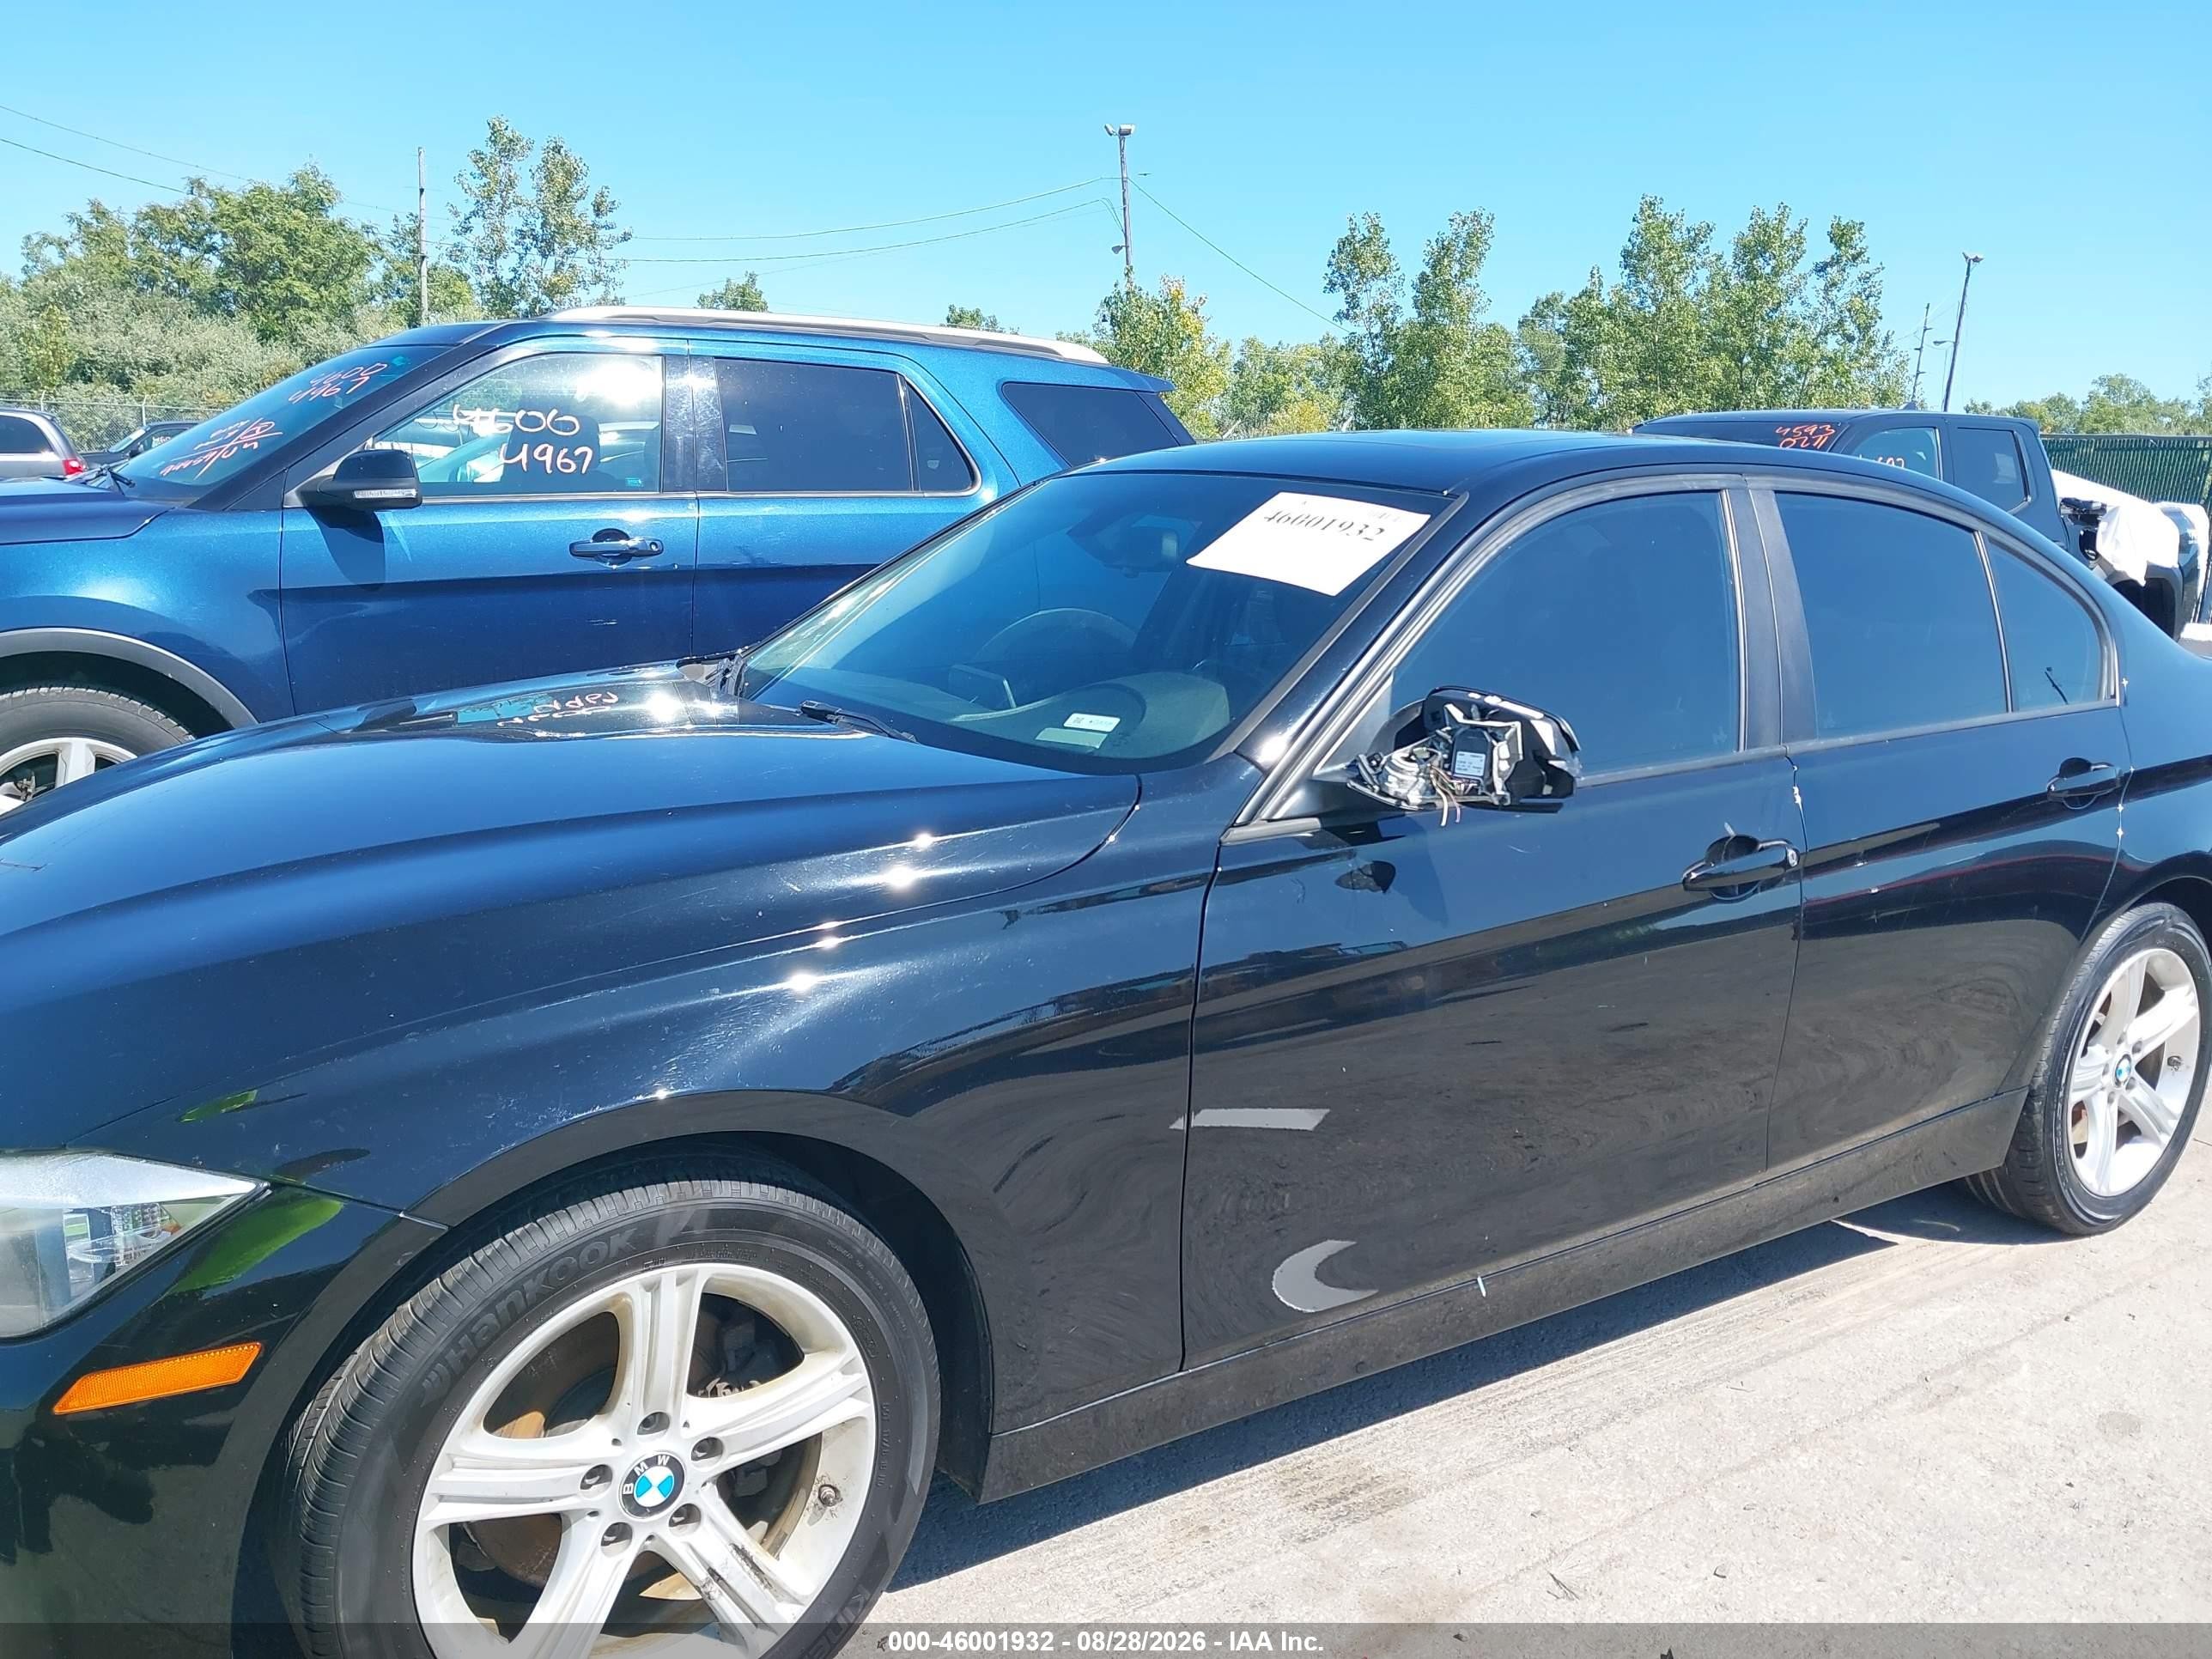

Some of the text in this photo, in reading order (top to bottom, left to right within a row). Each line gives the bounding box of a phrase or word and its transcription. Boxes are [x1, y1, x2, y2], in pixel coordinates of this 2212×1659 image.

[288, 376, 370, 404] 4967
[1775, 424, 1835, 439] 4593
[499, 442, 592, 474] 4967
[1263, 510, 1385, 541] 46001932
[623, 1455, 670, 1494] BMW
